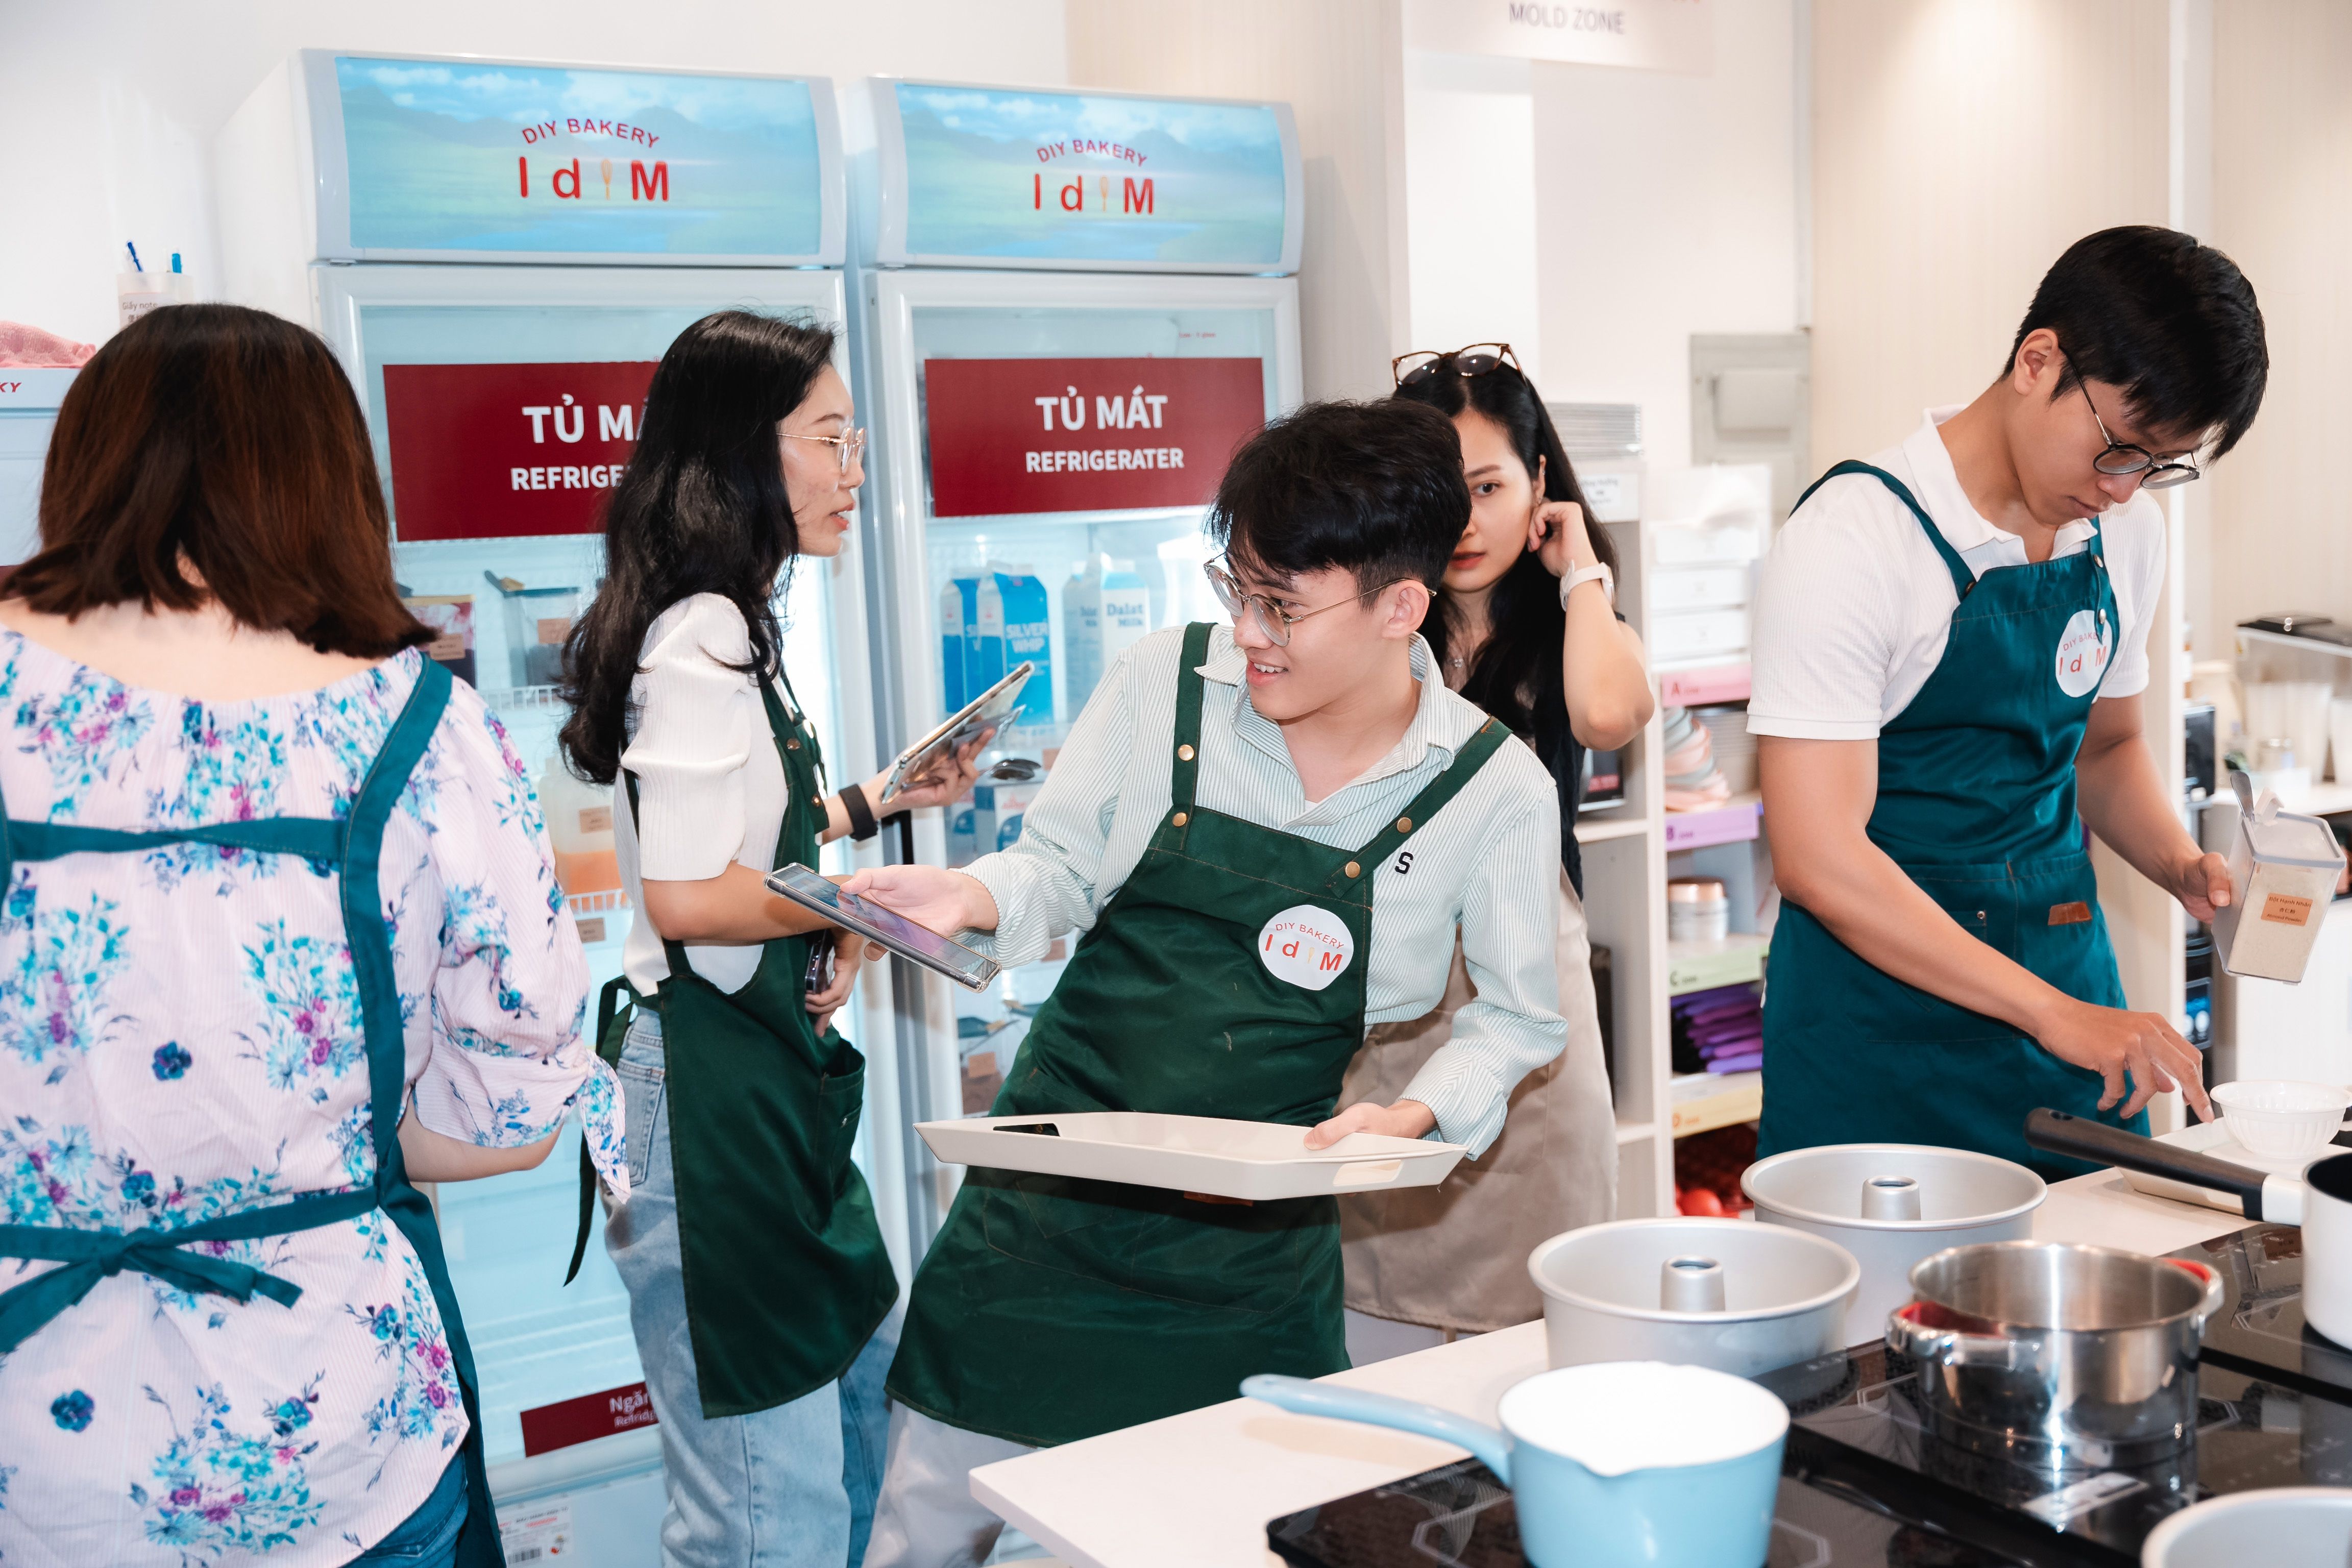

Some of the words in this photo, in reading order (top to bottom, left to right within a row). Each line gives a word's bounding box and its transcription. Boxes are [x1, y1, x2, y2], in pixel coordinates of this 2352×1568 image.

[1509, 2, 1567, 29] MOLD
[1573, 9, 1625, 35] ZONE
[522, 120, 557, 144] DIY
[567, 118, 660, 149] BAKERY
[1037, 141, 1065, 163] DIY
[1073, 139, 1147, 167] BAKERY
[522, 393, 585, 444] TỦ
[598, 396, 647, 442] M
[1035, 385, 1086, 431] TỦ
[1096, 384, 1168, 430] MÁT
[1026, 448, 1185, 473] REFRIGERATER
[511, 464, 631, 491] REFRIGE
[2063, 638, 2076, 651] DIY
[2079, 632, 2106, 643] BAKE
[1395, 852, 1414, 875] S
[1276, 922, 1295, 931] DIY
[1300, 924, 1344, 949] BAKERY
